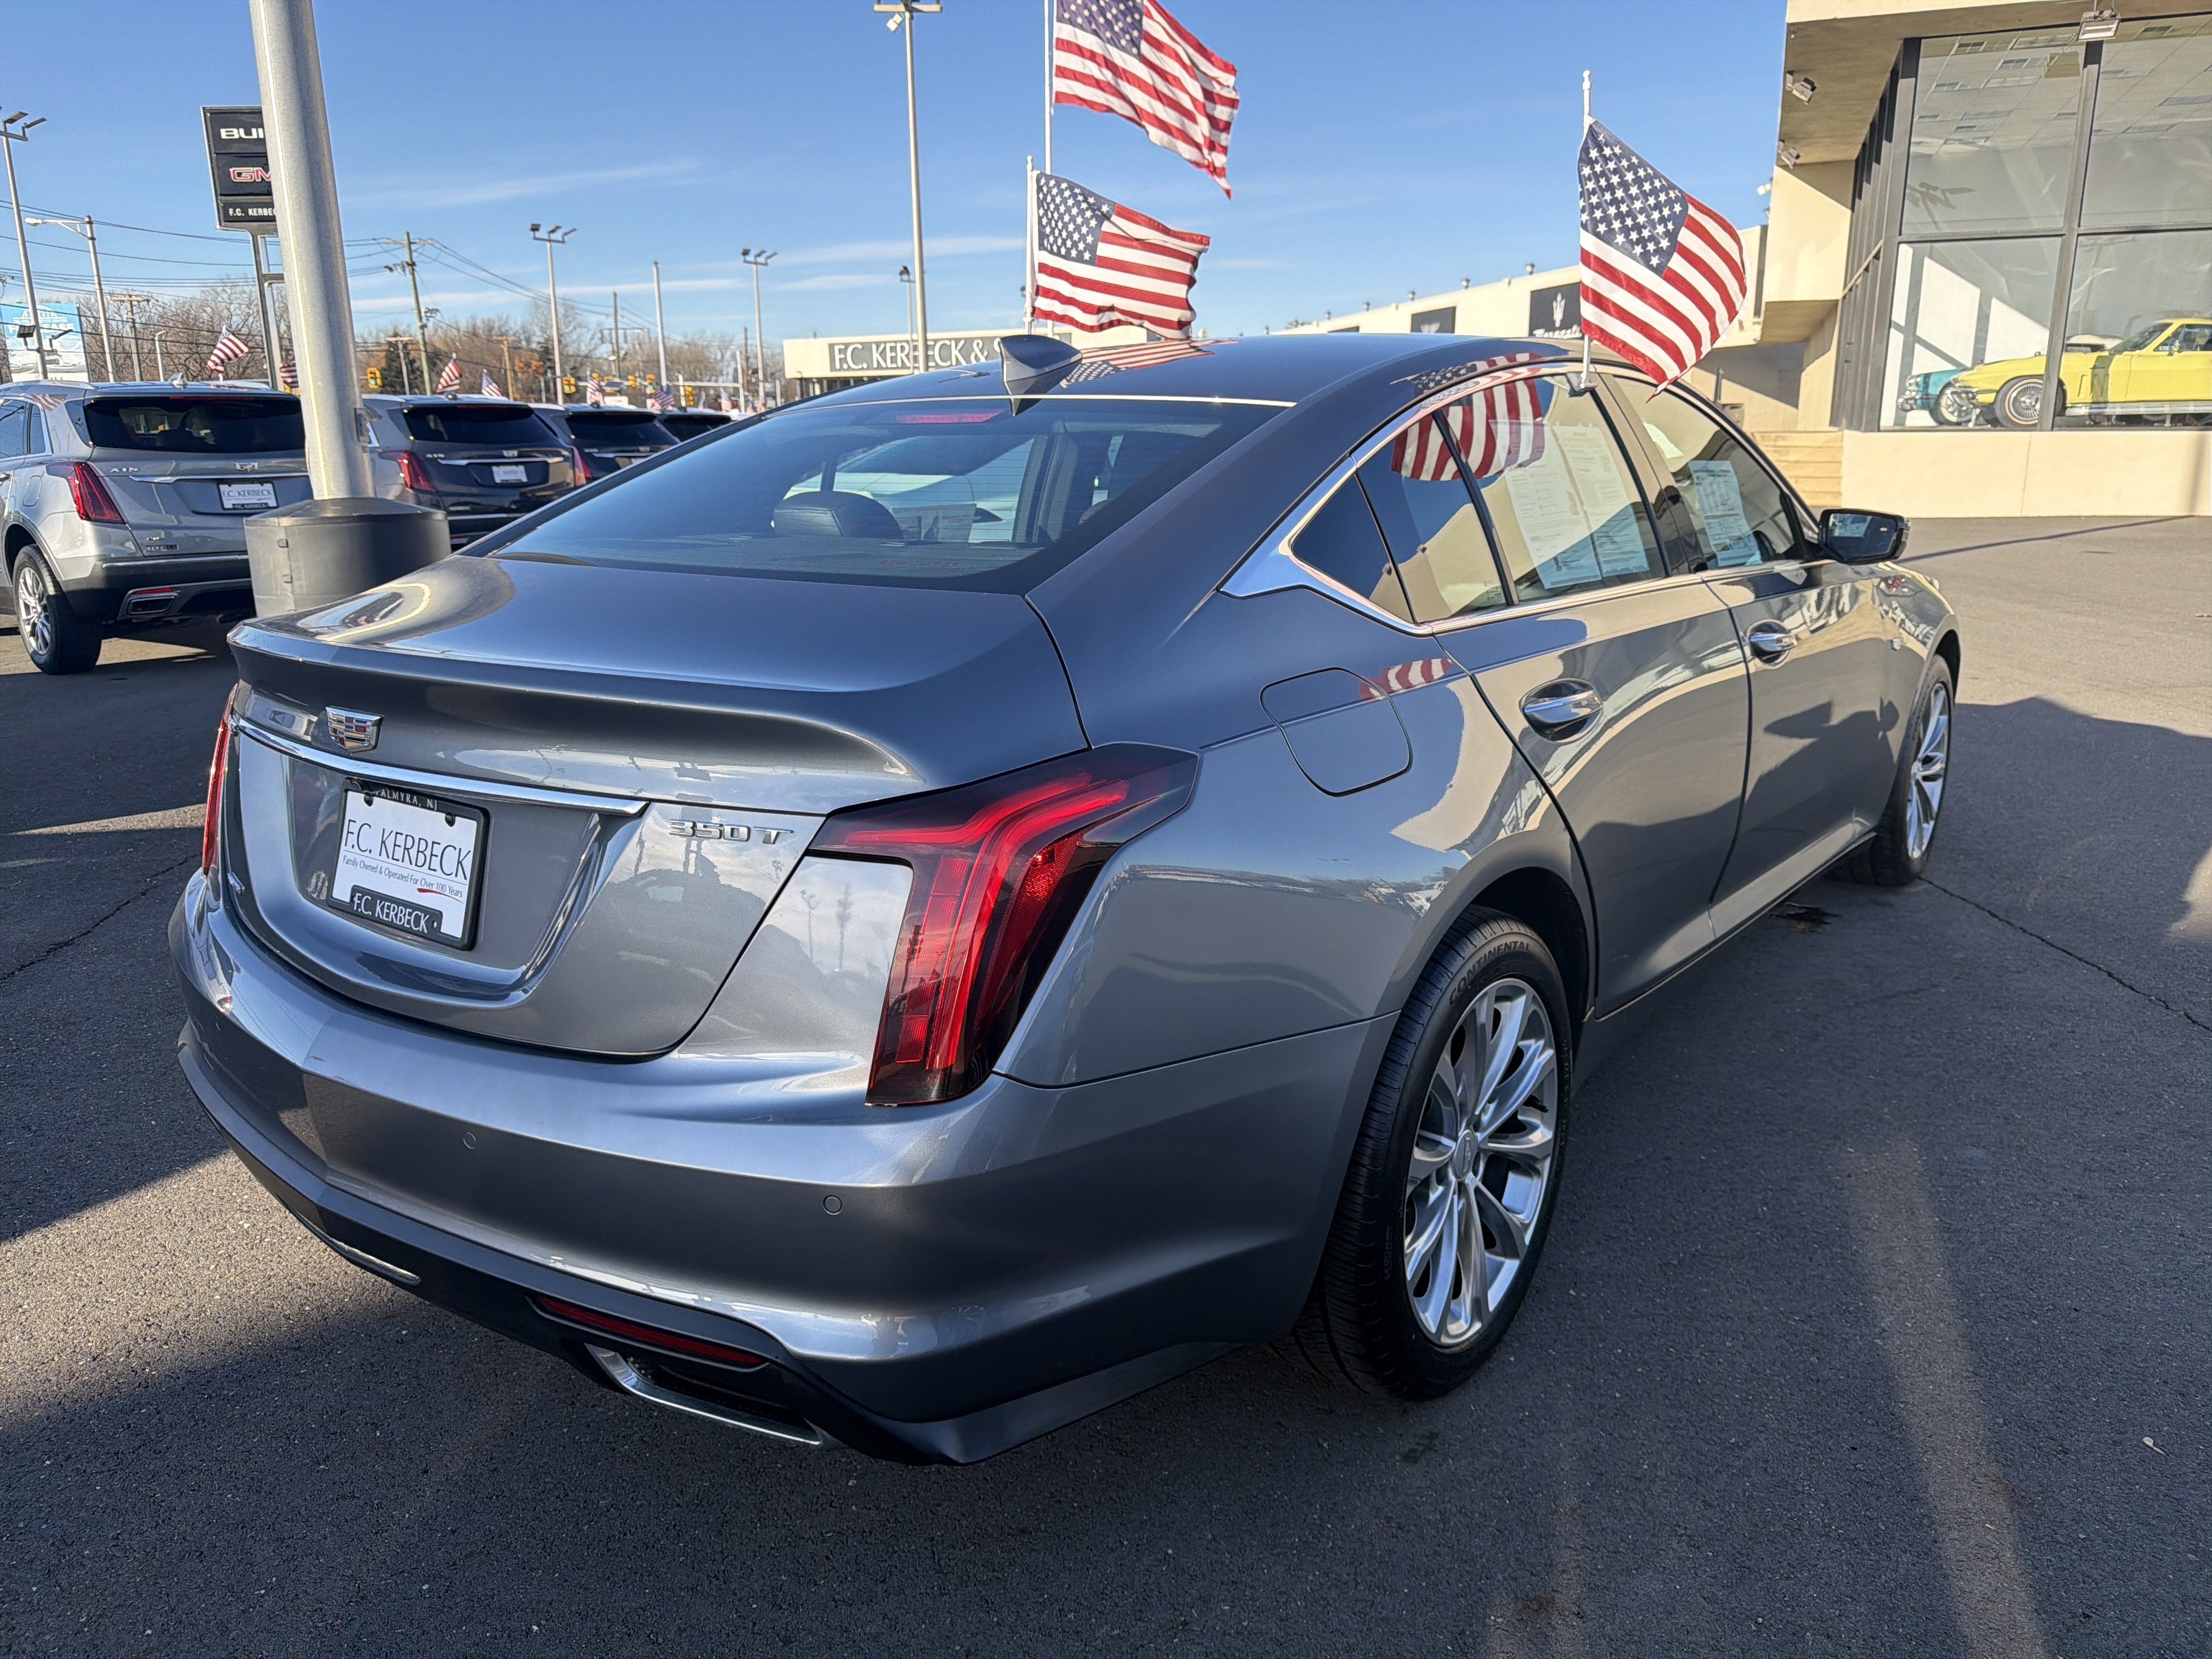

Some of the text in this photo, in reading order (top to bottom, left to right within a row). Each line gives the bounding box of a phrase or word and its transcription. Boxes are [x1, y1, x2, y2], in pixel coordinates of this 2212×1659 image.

[229, 208, 245, 216] F.C.
[834, 344, 867, 369] F.C.
[970, 338, 988, 364] &
[426, 798, 437, 811] NJ
[345, 819, 471, 881] F.C. KERBECK
[342, 855, 462, 898] Family Owned & Operated For Over 100 Years
[354, 893, 430, 934] F.C. KERBECK
[1449, 941, 1531, 1006] CONTINENTAL
